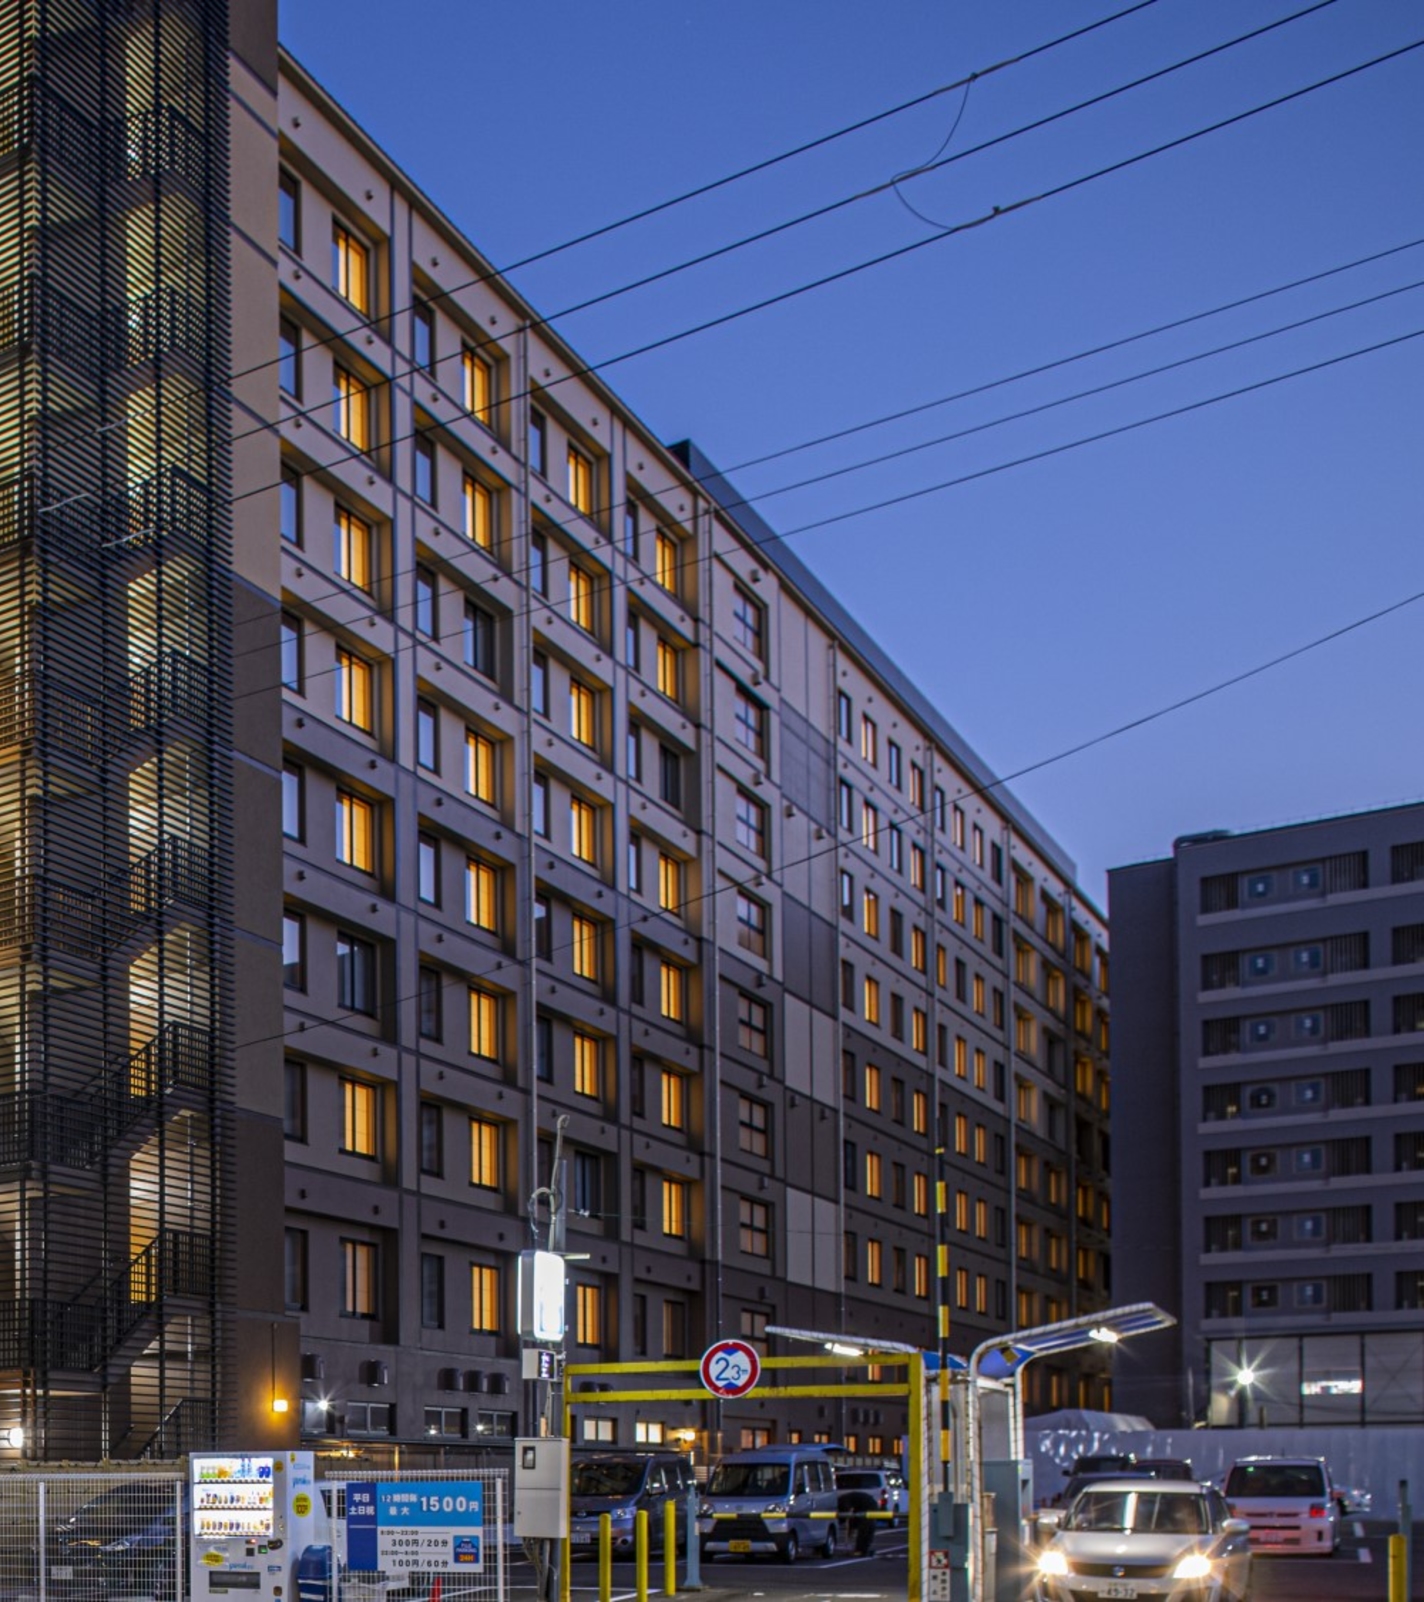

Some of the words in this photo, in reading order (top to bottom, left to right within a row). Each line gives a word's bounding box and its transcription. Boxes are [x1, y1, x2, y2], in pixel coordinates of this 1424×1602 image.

[353, 1493, 370, 1503] 平日
[420, 1496, 479, 1512] 1500円
[349, 1505, 375, 1515] 土日祝
[391, 1539, 449, 1547] 300円/20分
[392, 1559, 449, 1567] 100円/60分
